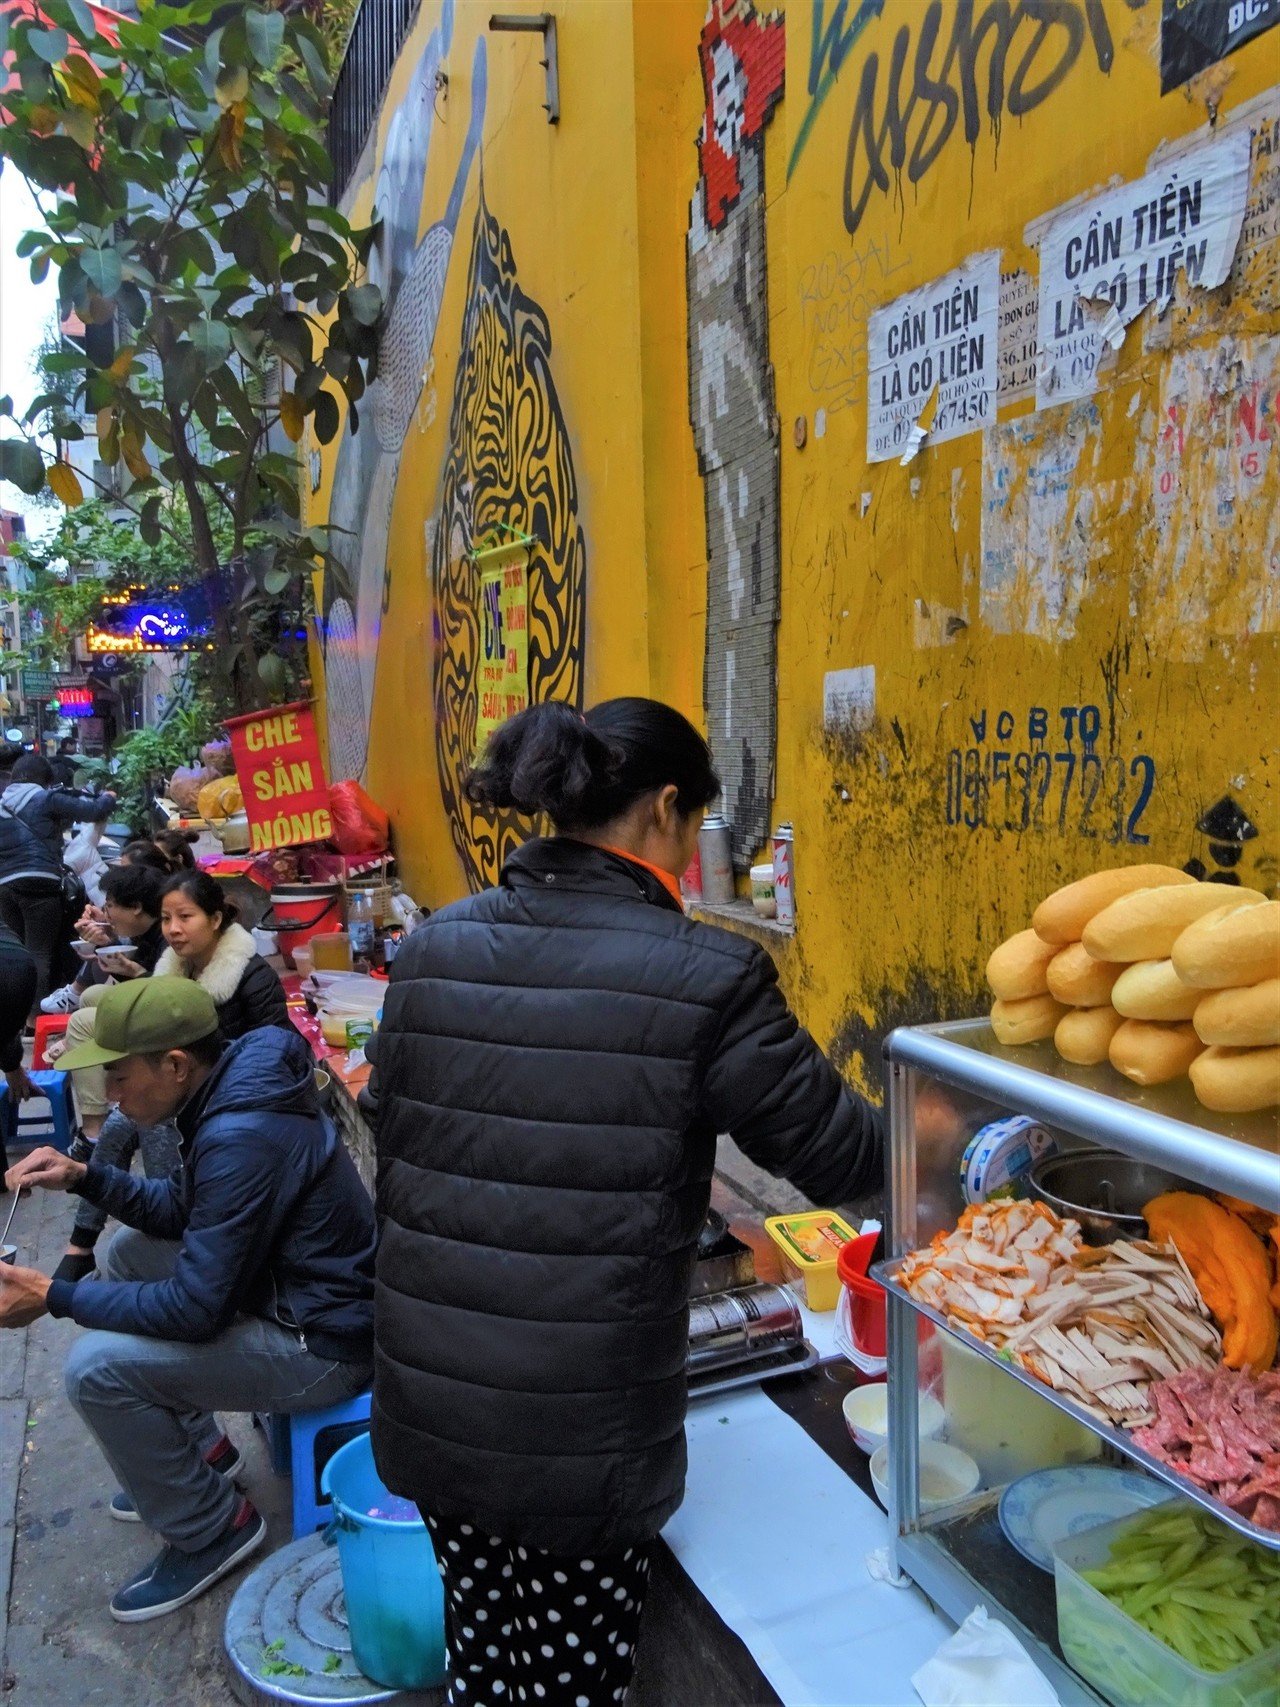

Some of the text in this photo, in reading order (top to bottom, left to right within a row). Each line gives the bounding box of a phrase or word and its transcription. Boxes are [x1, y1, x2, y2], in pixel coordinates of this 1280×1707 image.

[1065, 174, 1203, 281] CẦN TIỀN
[888, 278, 979, 360] CẦN TIỀN
[1055, 284, 1085, 340] LÀ
[881, 363, 902, 407] LÀ
[908, 349, 933, 397] CÓ
[939, 327, 985, 385] LIỀN
[251, 809, 332, 852] NÓNG
